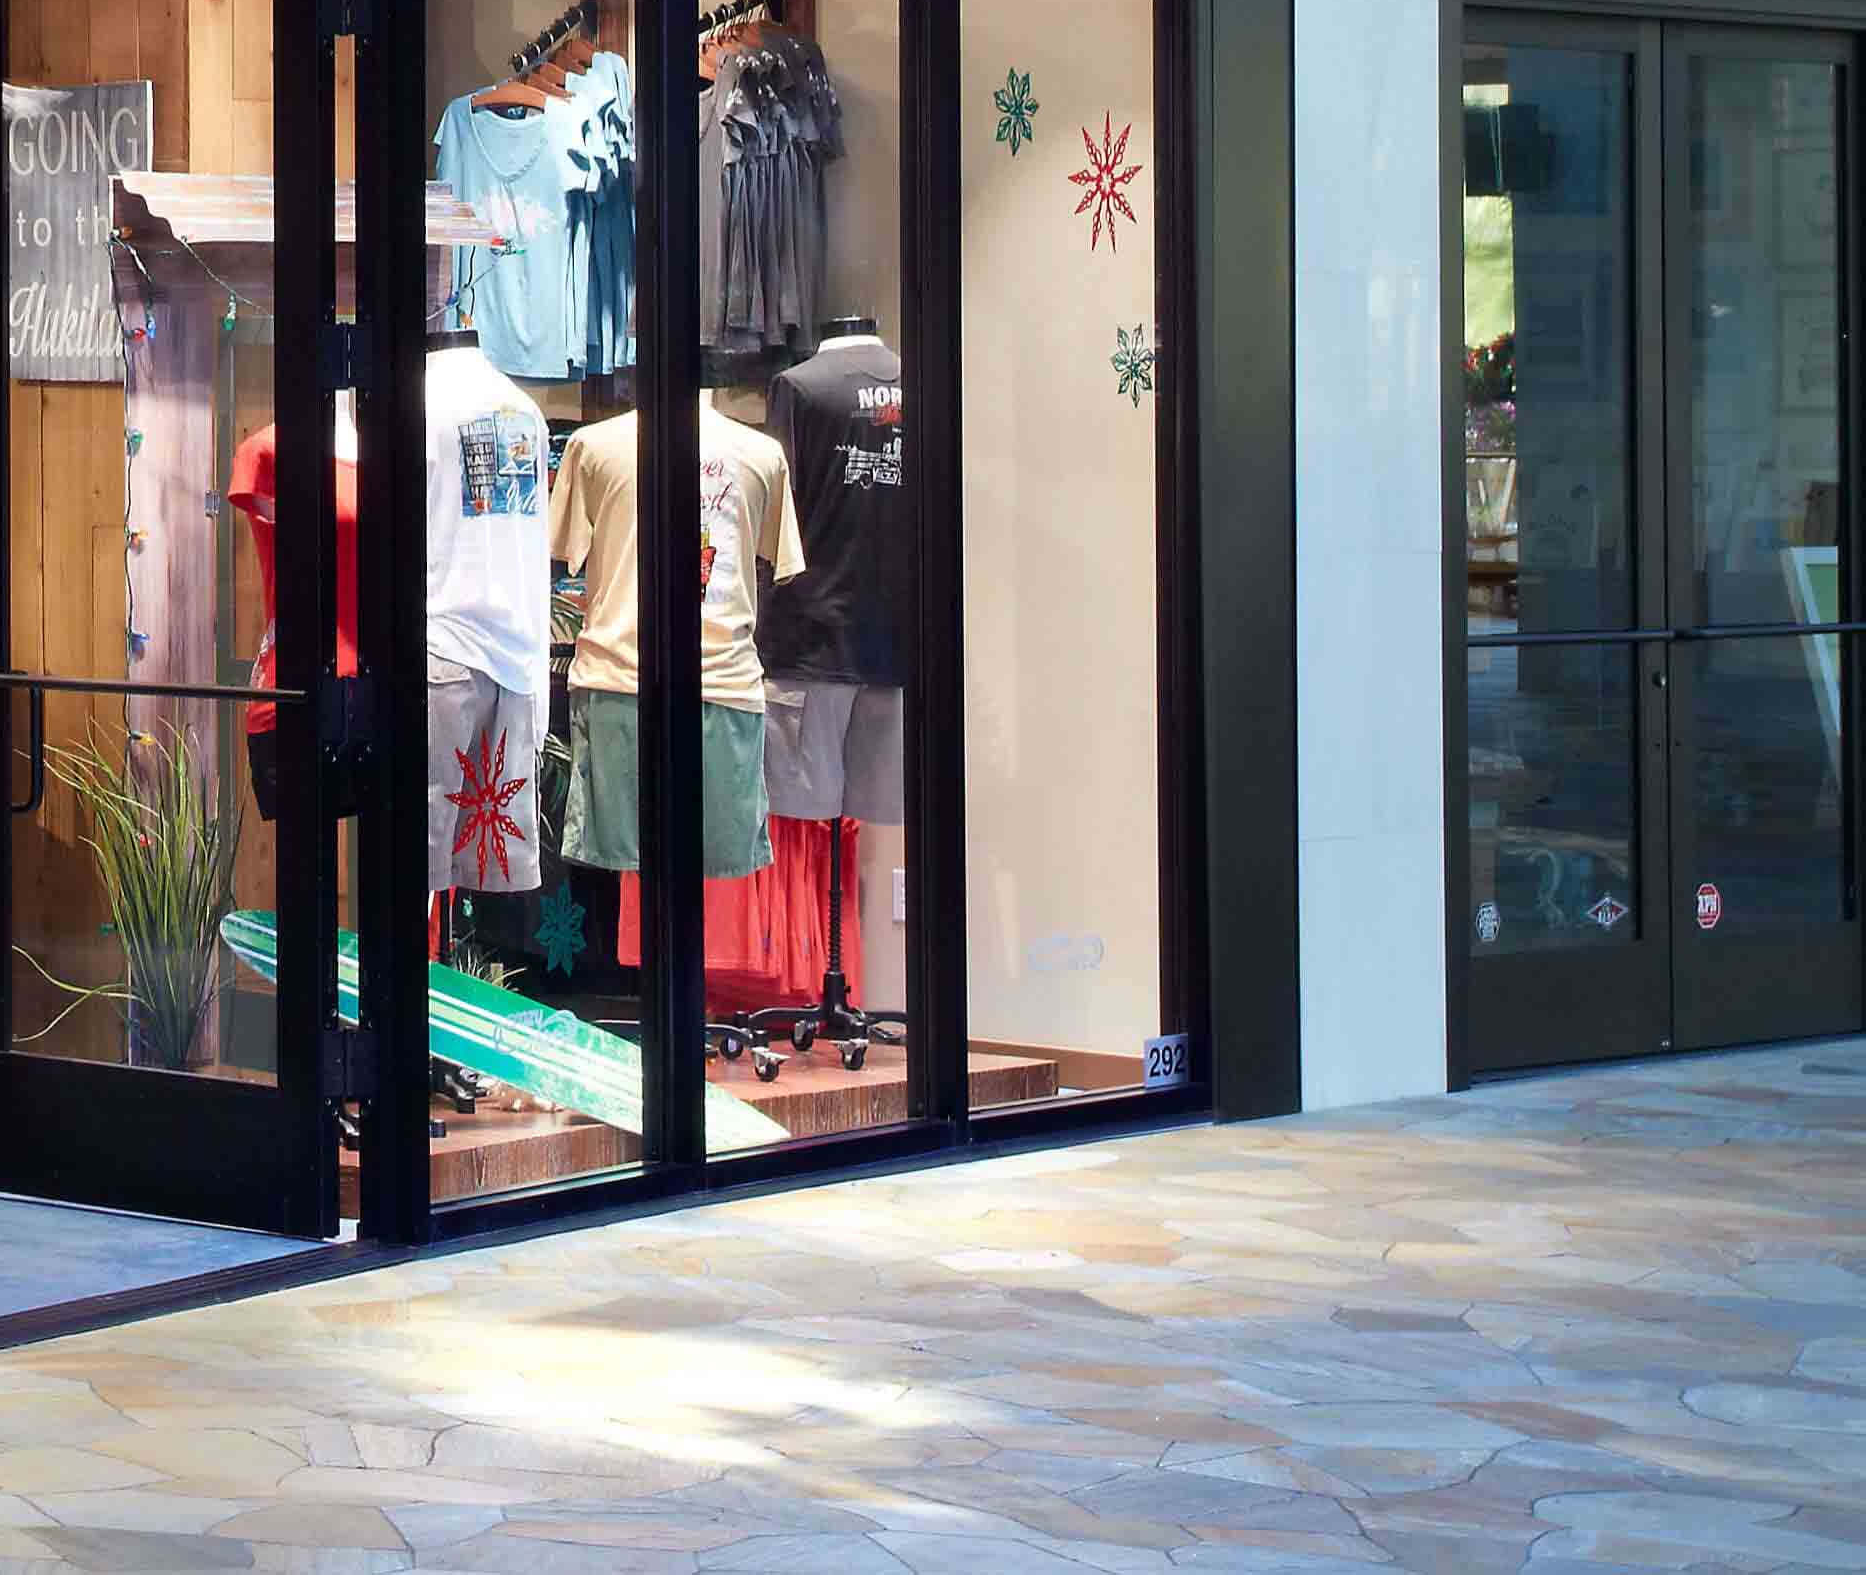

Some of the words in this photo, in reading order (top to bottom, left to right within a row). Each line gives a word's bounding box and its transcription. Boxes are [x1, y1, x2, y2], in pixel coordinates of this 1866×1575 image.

[9, 107, 139, 176] GOING
[15, 209, 53, 247] to
[75, 205, 110, 247] th
[1148, 1043, 1186, 1078] 292
